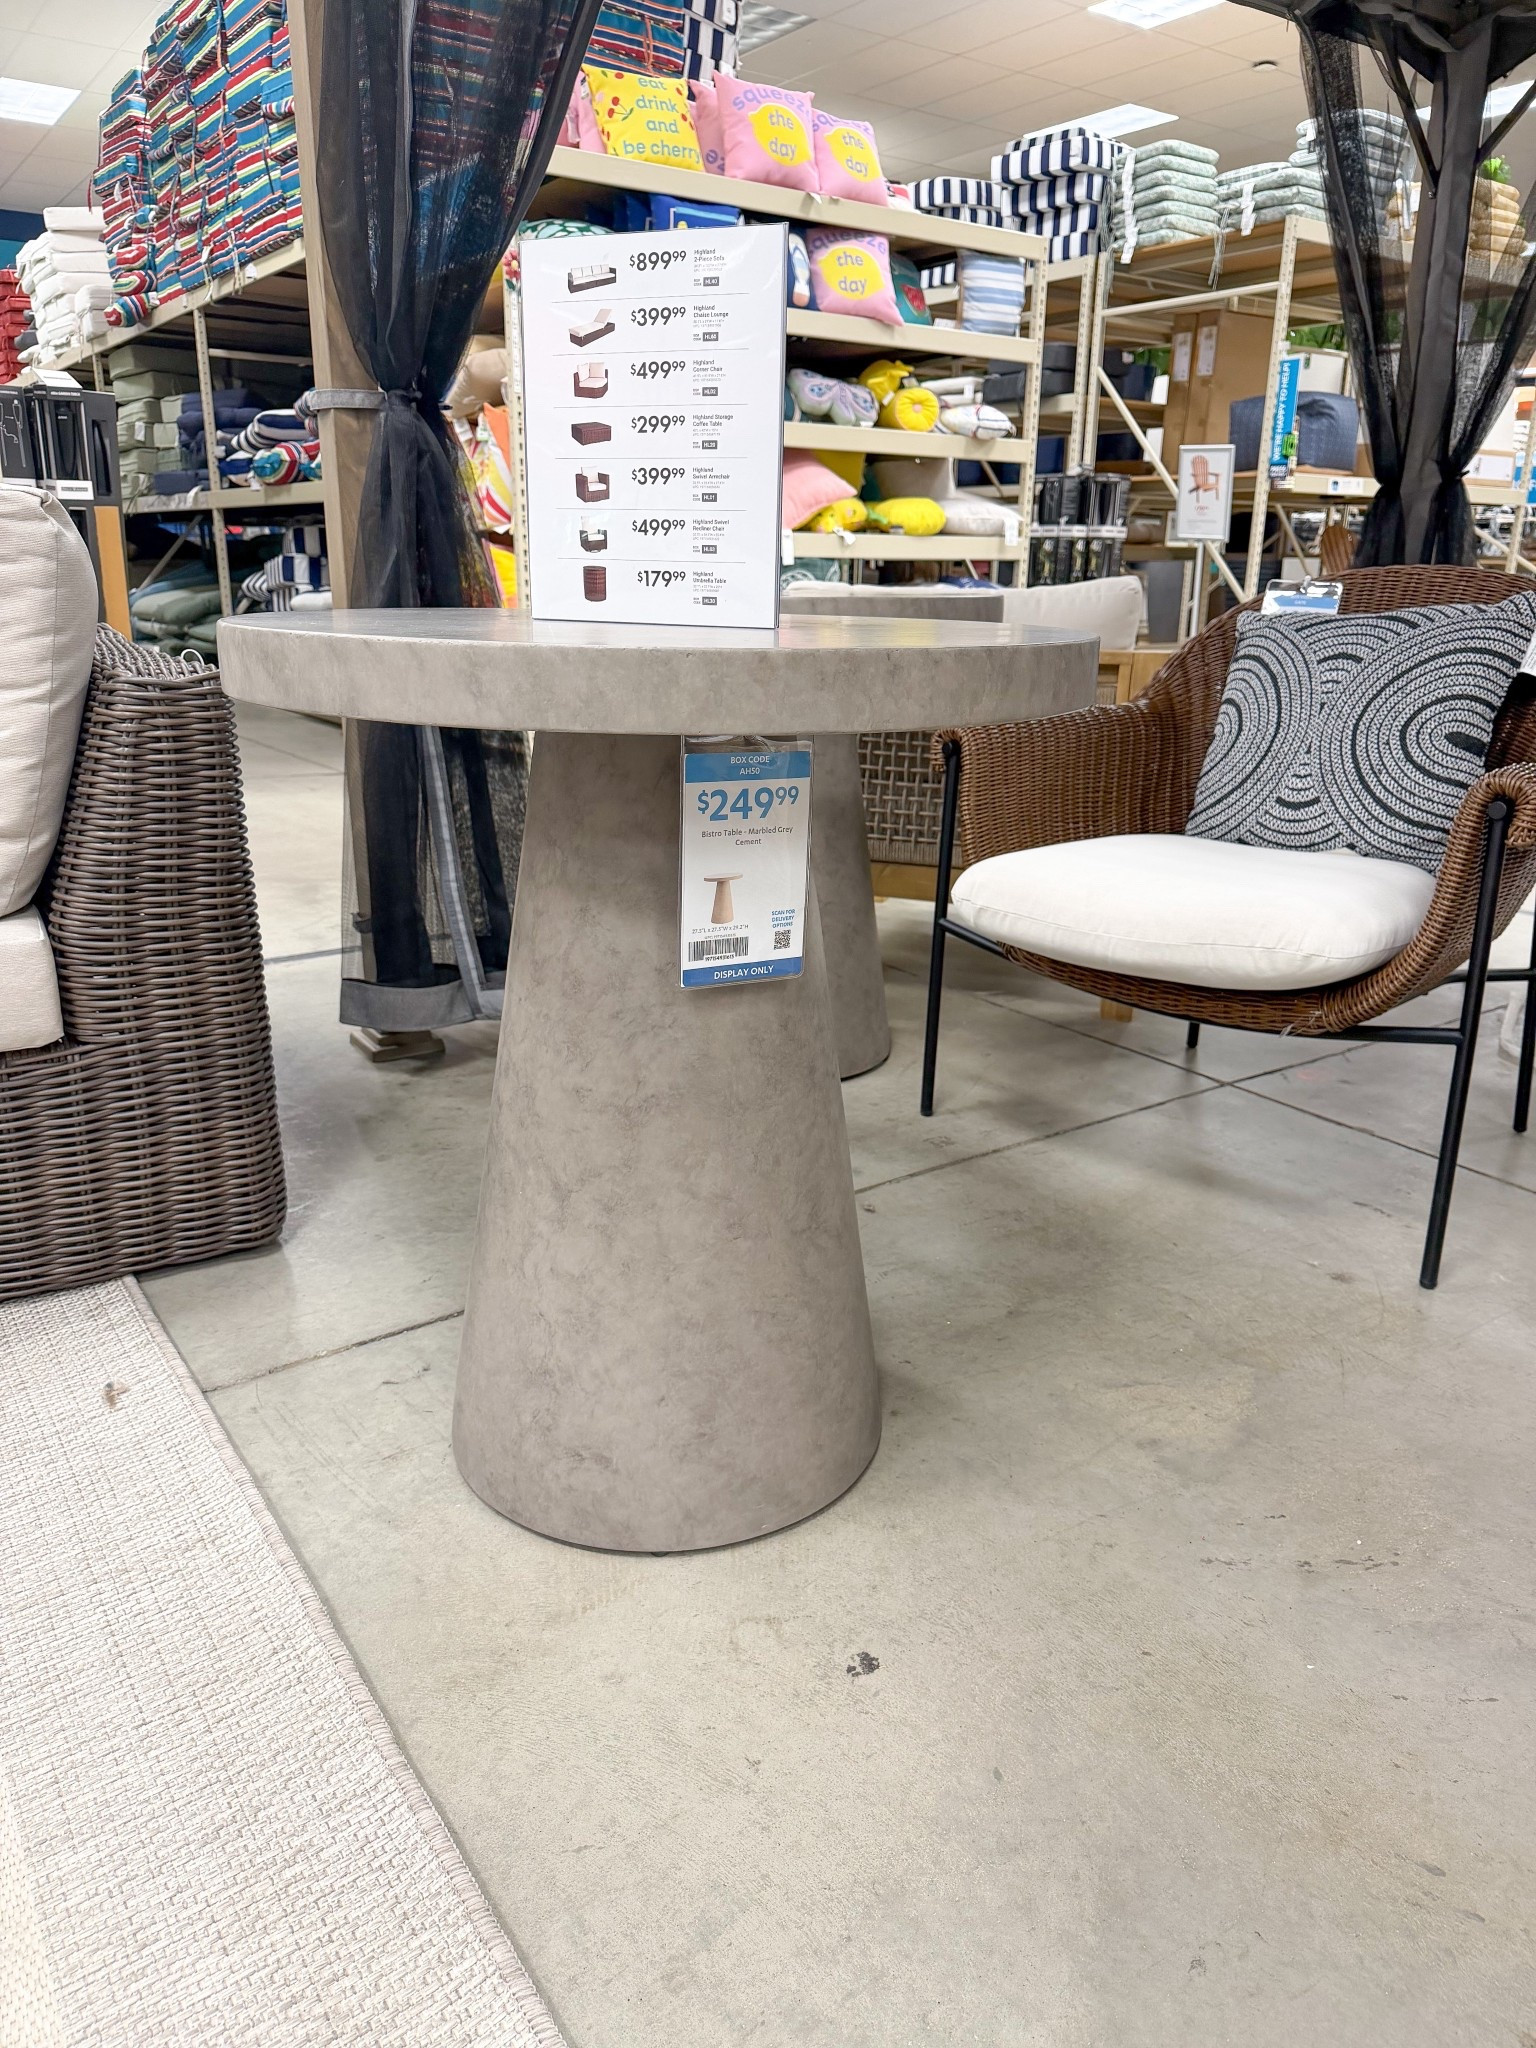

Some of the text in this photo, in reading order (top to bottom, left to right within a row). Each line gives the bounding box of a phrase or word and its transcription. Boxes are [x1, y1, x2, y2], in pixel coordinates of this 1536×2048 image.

[637, 77, 667, 90] eat
[635, 94, 679, 113] drink
[646, 119, 679, 134] and
[768, 110, 794, 129] the
[768, 137, 797, 160] day
[842, 132, 865, 149] the
[623, 140, 646, 155] be
[650, 140, 701, 164] cherry
[845, 156, 869, 177] day
[629, 250, 686, 271] $89999
[836, 251, 864, 266] the
[838, 277, 867, 295] day
[630, 306, 686, 326] $39999
[630, 360, 686, 379] $49999
[631, 415, 686, 433] $29999
[631, 467, 686, 485] $39999
[632, 519, 686, 536] $49999
[637, 570, 686, 588] $17999
[748, 755, 770, 763] CODE
[739, 767, 760, 775] AH50
[697, 785, 799, 822] $24999
[701, 830, 722, 838] Bistro
[723, 828, 742, 837] Table
[748, 826, 777, 835] Marbled
[777, 826, 793, 834] Grey
[735, 838, 762, 846] Cement
[714, 965, 774, 980] DISPLAY ONLY
